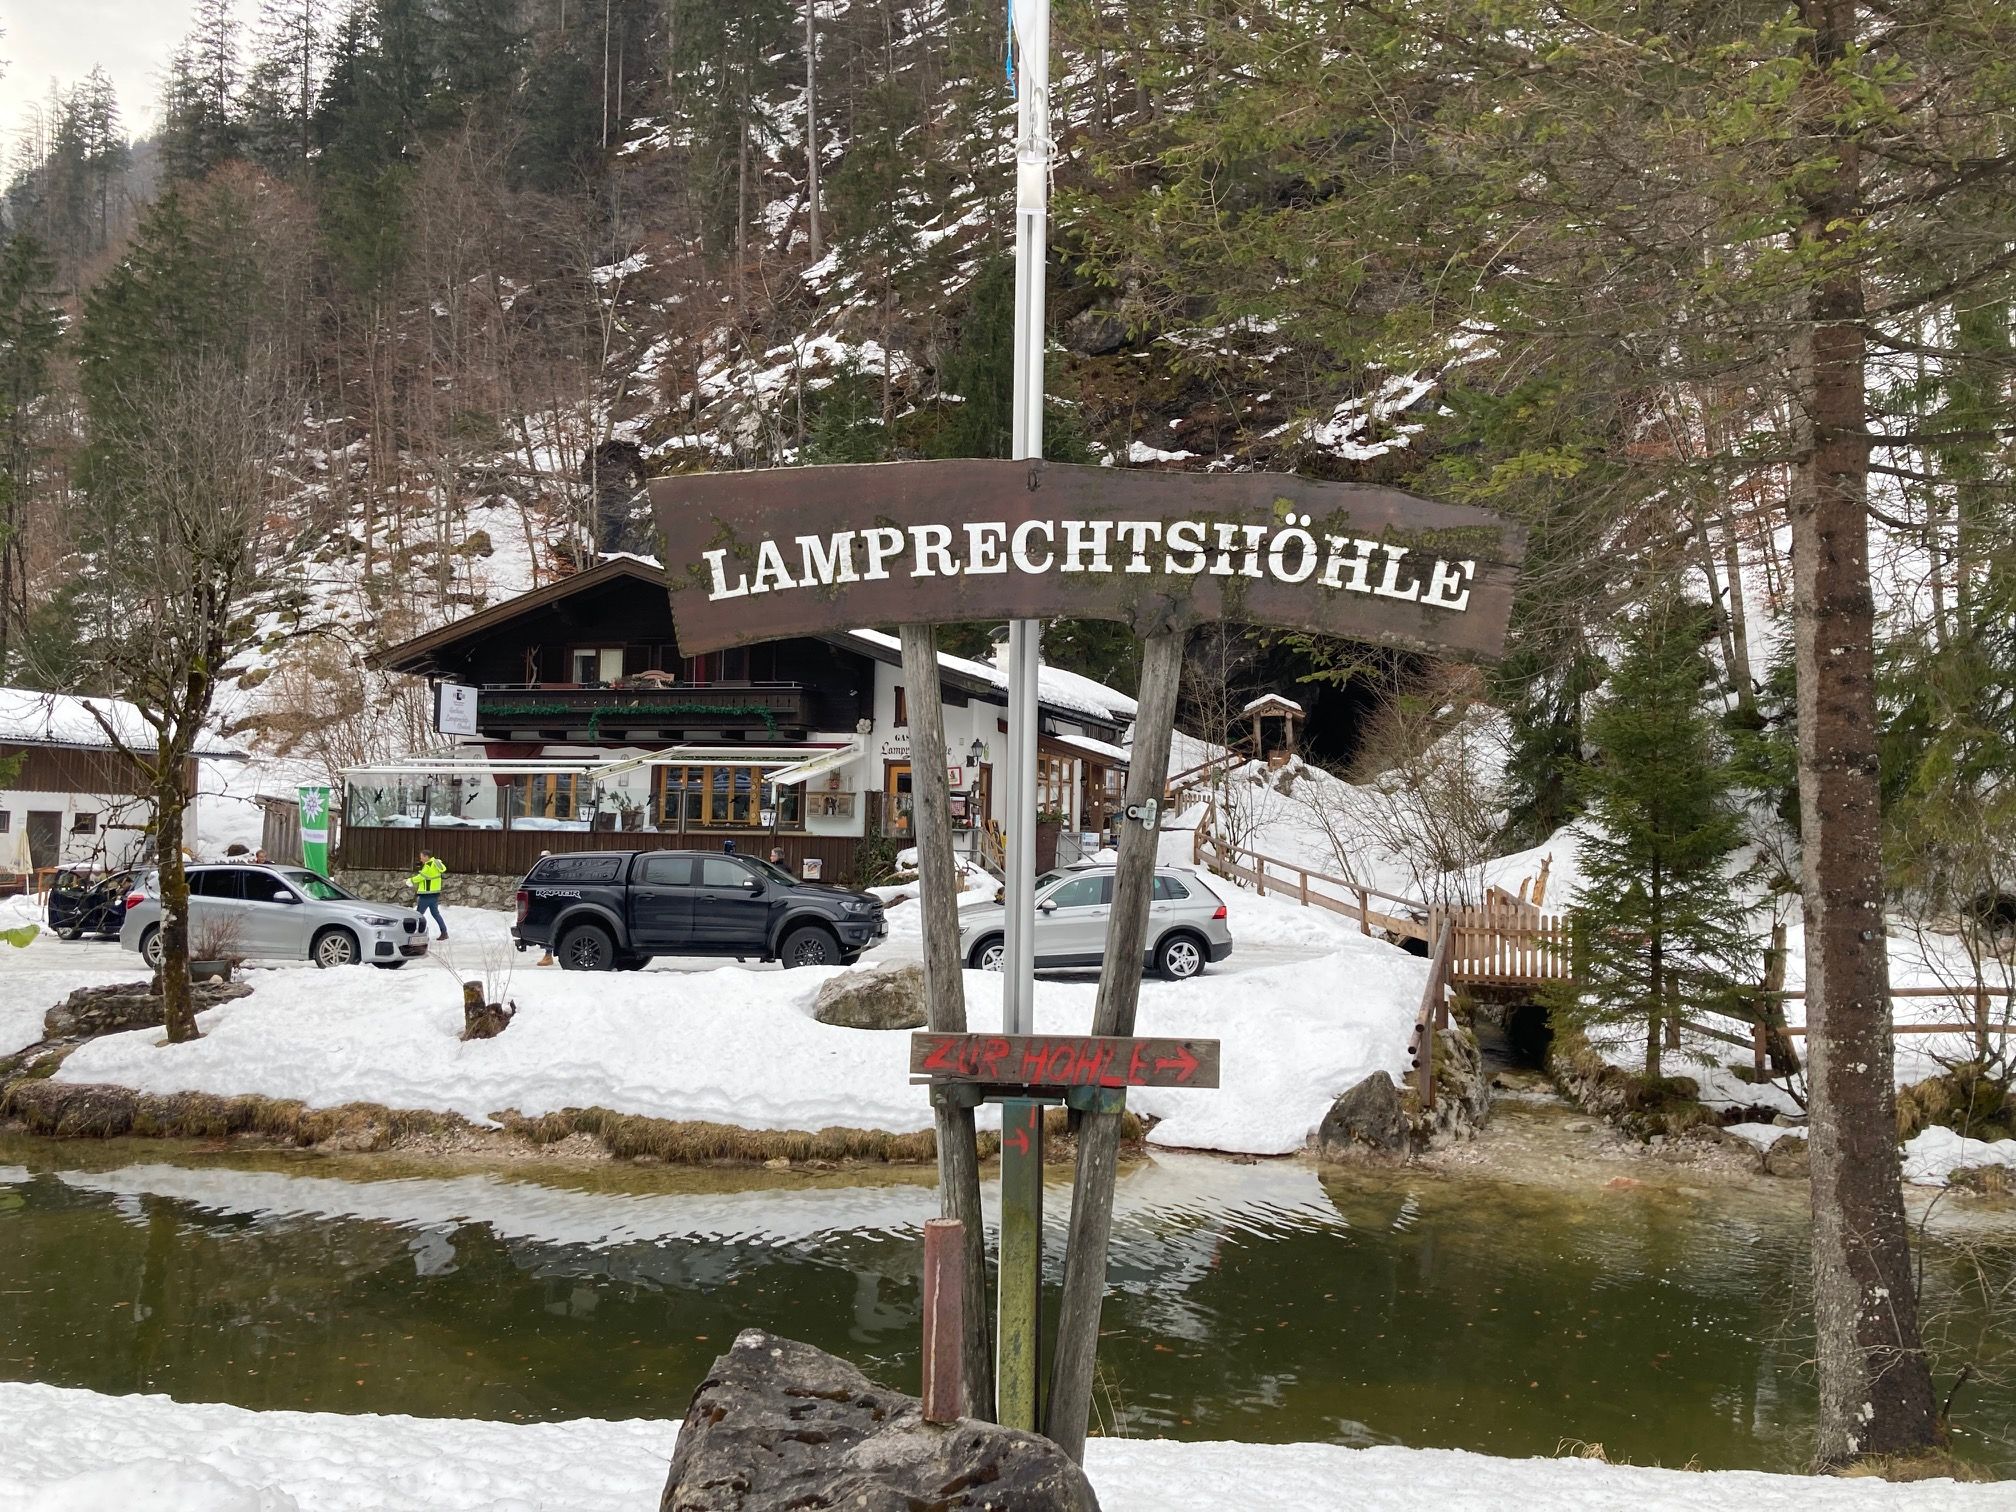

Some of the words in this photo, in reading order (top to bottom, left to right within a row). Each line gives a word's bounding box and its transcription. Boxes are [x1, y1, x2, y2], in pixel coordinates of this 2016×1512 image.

[702, 512, 1476, 612] LAMPRECHTSHÖHLE
[535, 889, 582, 900] RAPTOR
[923, 1038, 1012, 1079] ZUR
